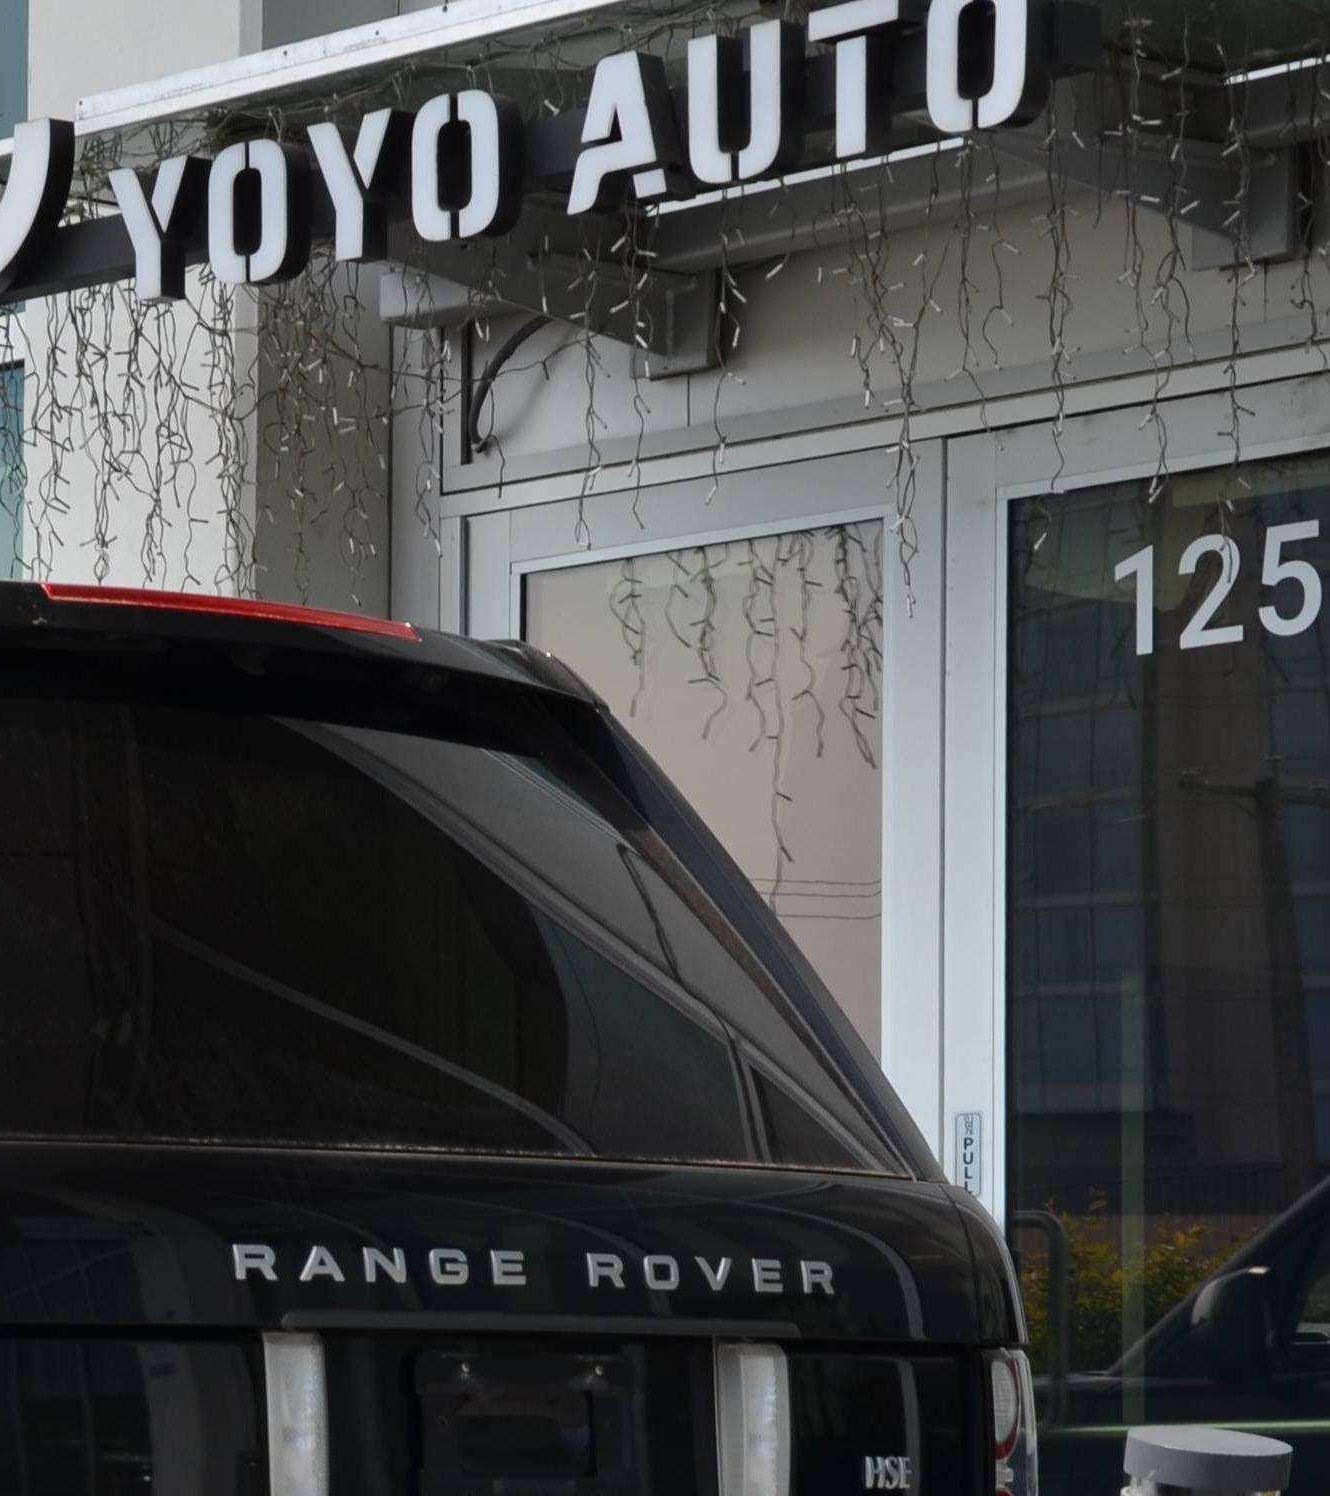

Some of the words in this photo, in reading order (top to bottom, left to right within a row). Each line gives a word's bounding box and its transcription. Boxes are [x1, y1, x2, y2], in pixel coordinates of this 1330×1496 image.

[109, 89, 502, 301] YOYO
[567, 0, 1030, 215] AUTO
[1113, 519, 1323, 656] 125
[232, 1243, 527, 1285] RANGE
[586, 1252, 835, 1295] ROVER
[865, 1455, 912, 1489] HSE
